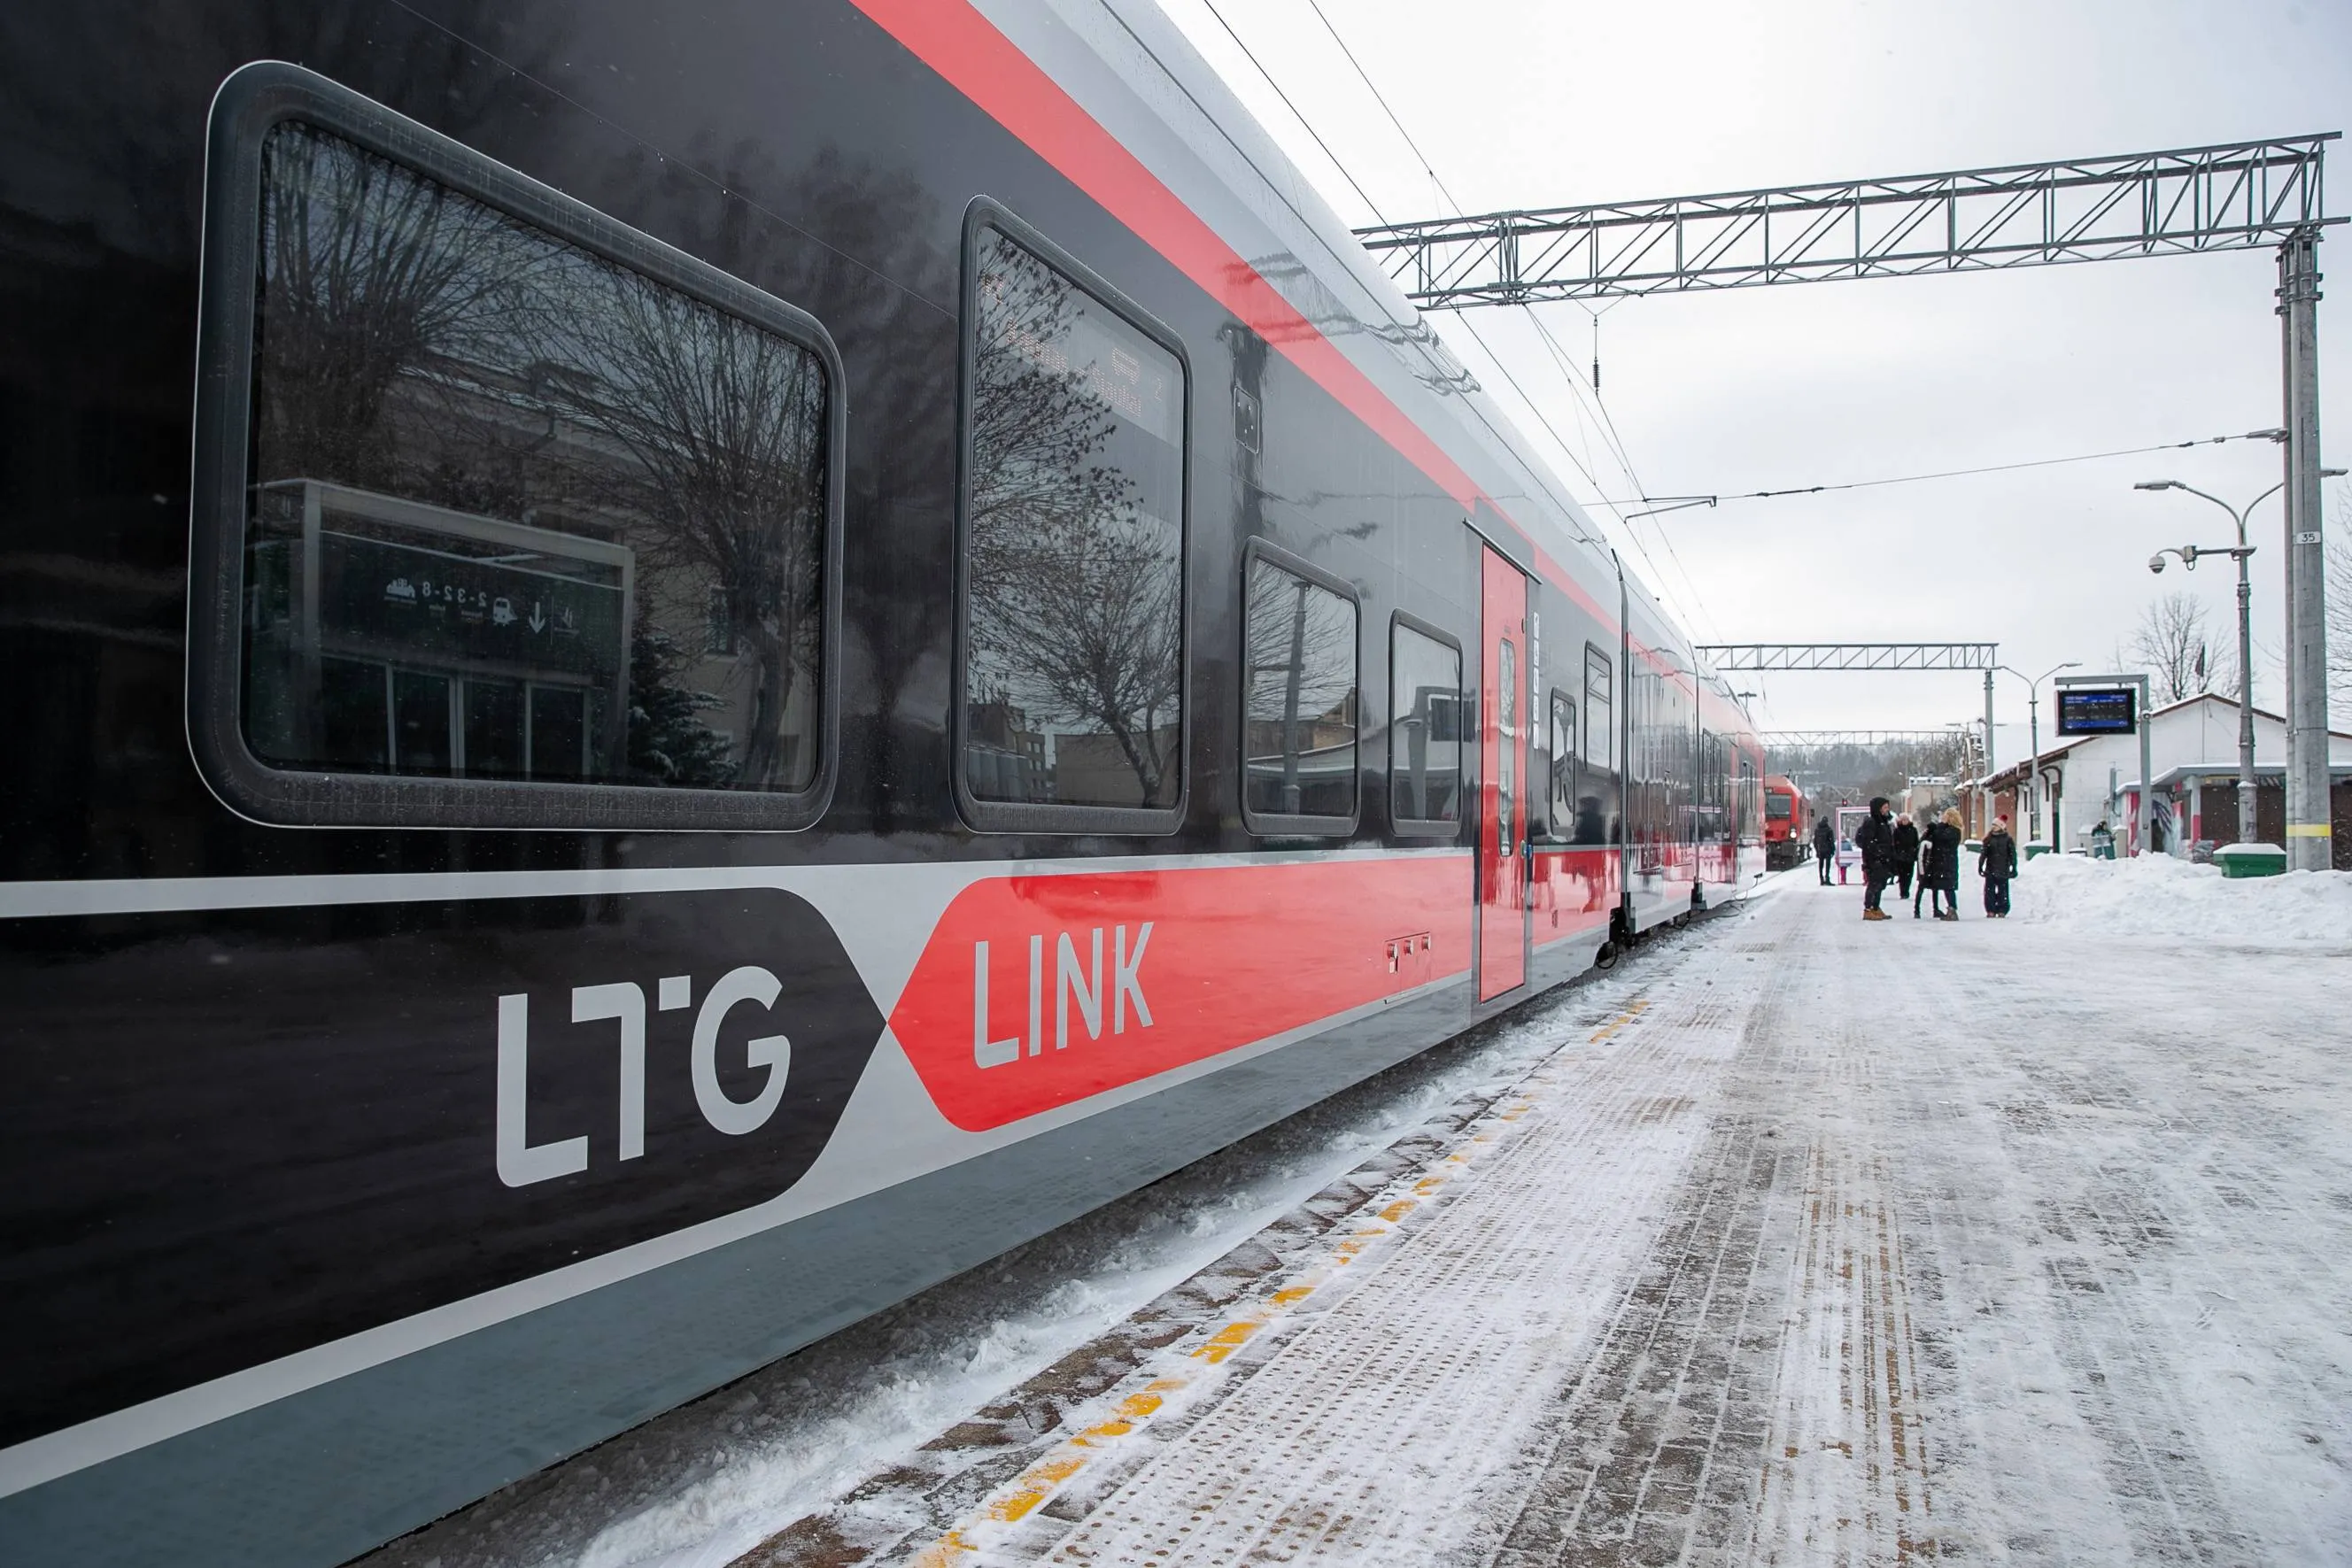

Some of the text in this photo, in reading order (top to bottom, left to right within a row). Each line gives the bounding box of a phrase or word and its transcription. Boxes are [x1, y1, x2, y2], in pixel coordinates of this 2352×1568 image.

[2302, 533, 2316, 542] 35
[497, 922, 1154, 1187] LTG LINK
